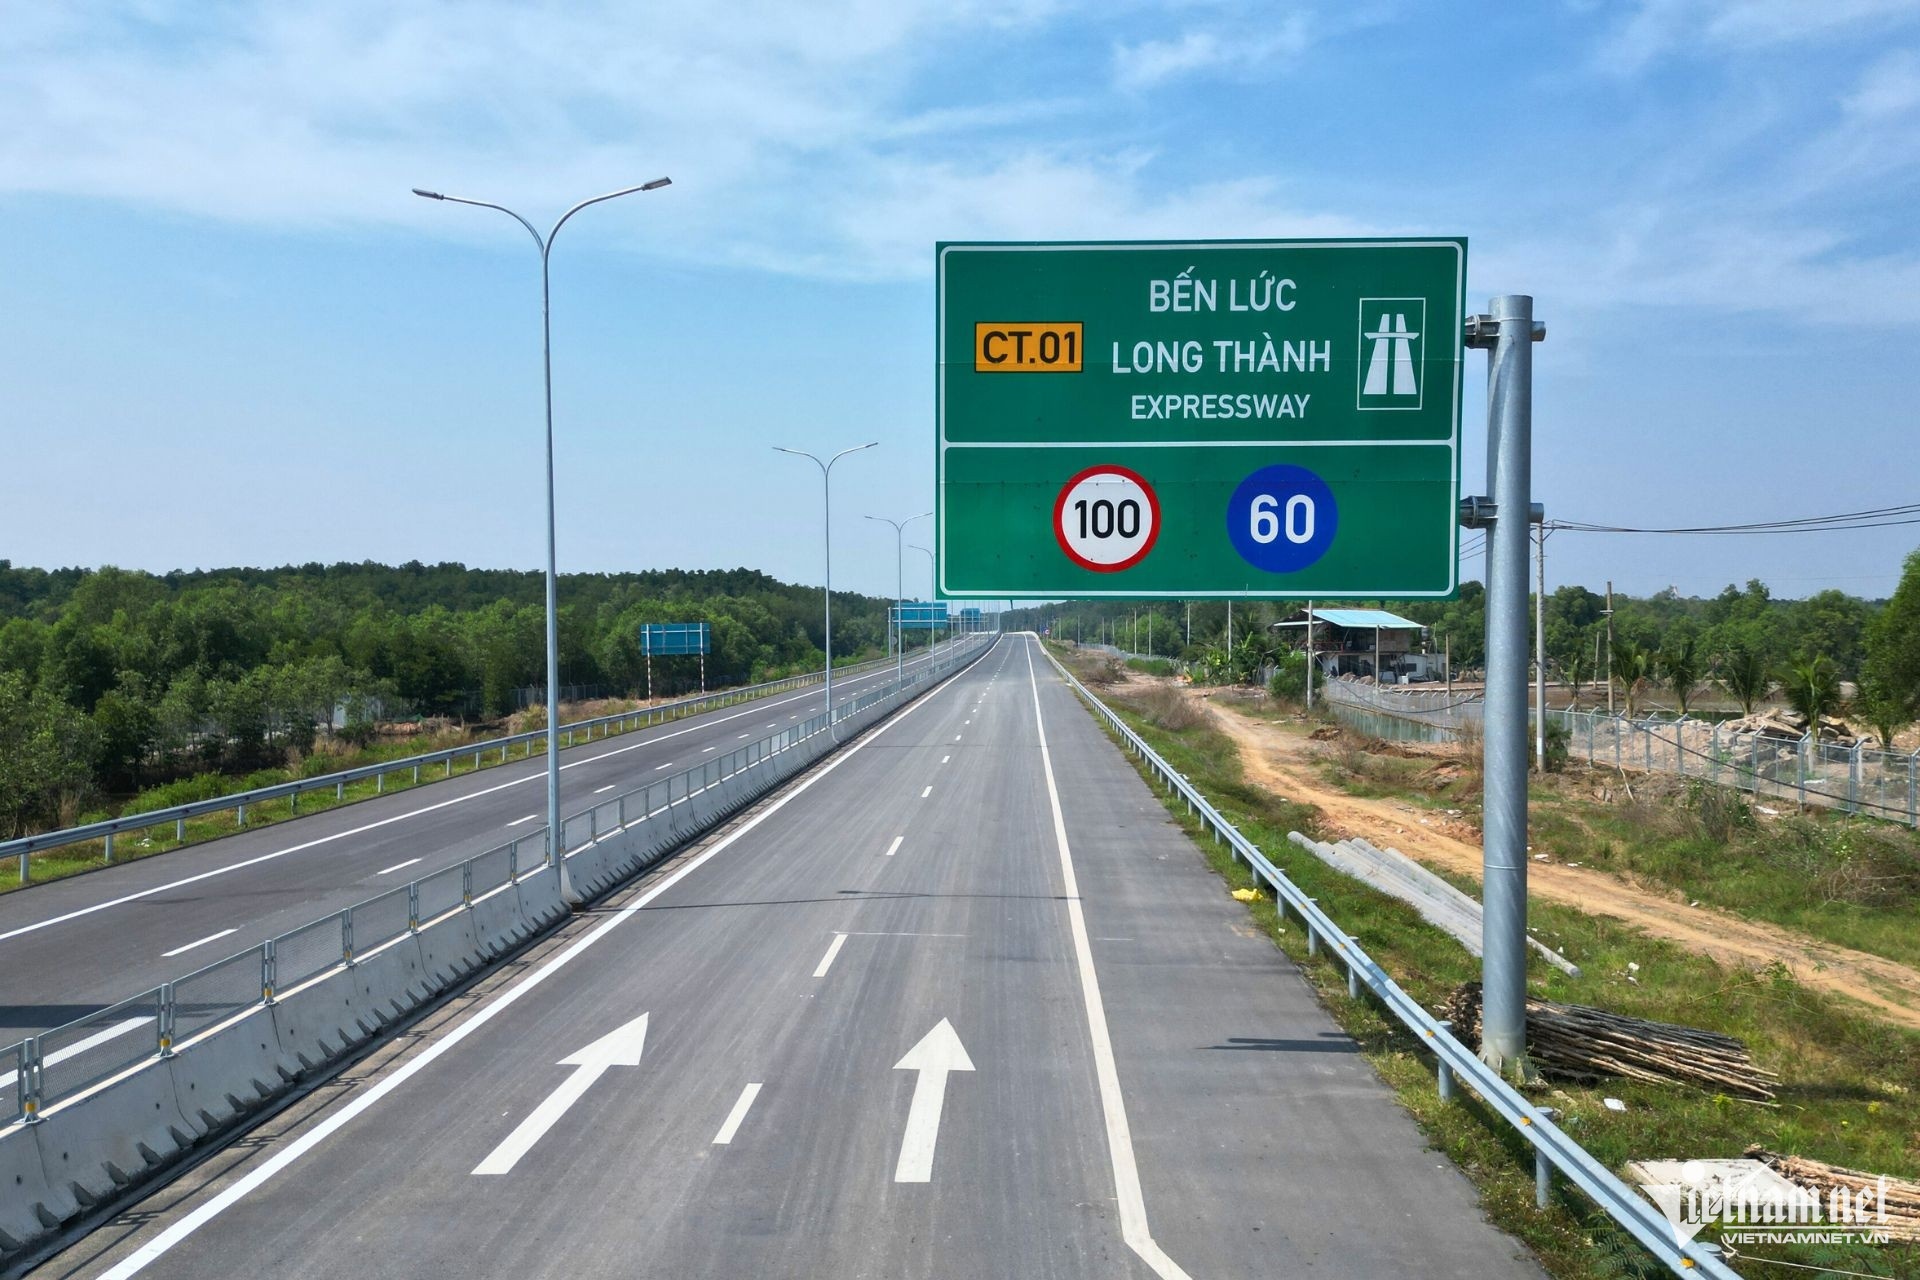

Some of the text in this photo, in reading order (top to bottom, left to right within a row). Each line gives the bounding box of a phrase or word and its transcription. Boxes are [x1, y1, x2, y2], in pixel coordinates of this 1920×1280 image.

[1149, 266, 1297, 313] BẾN LỨC
[982, 331, 1076, 365] CT.01
[1113, 331, 1331, 374] LONG THÀNH
[1131, 394, 1311, 420] EXPRESSWAY
[1074, 499, 1141, 539] 100
[1249, 494, 1316, 544] 60
